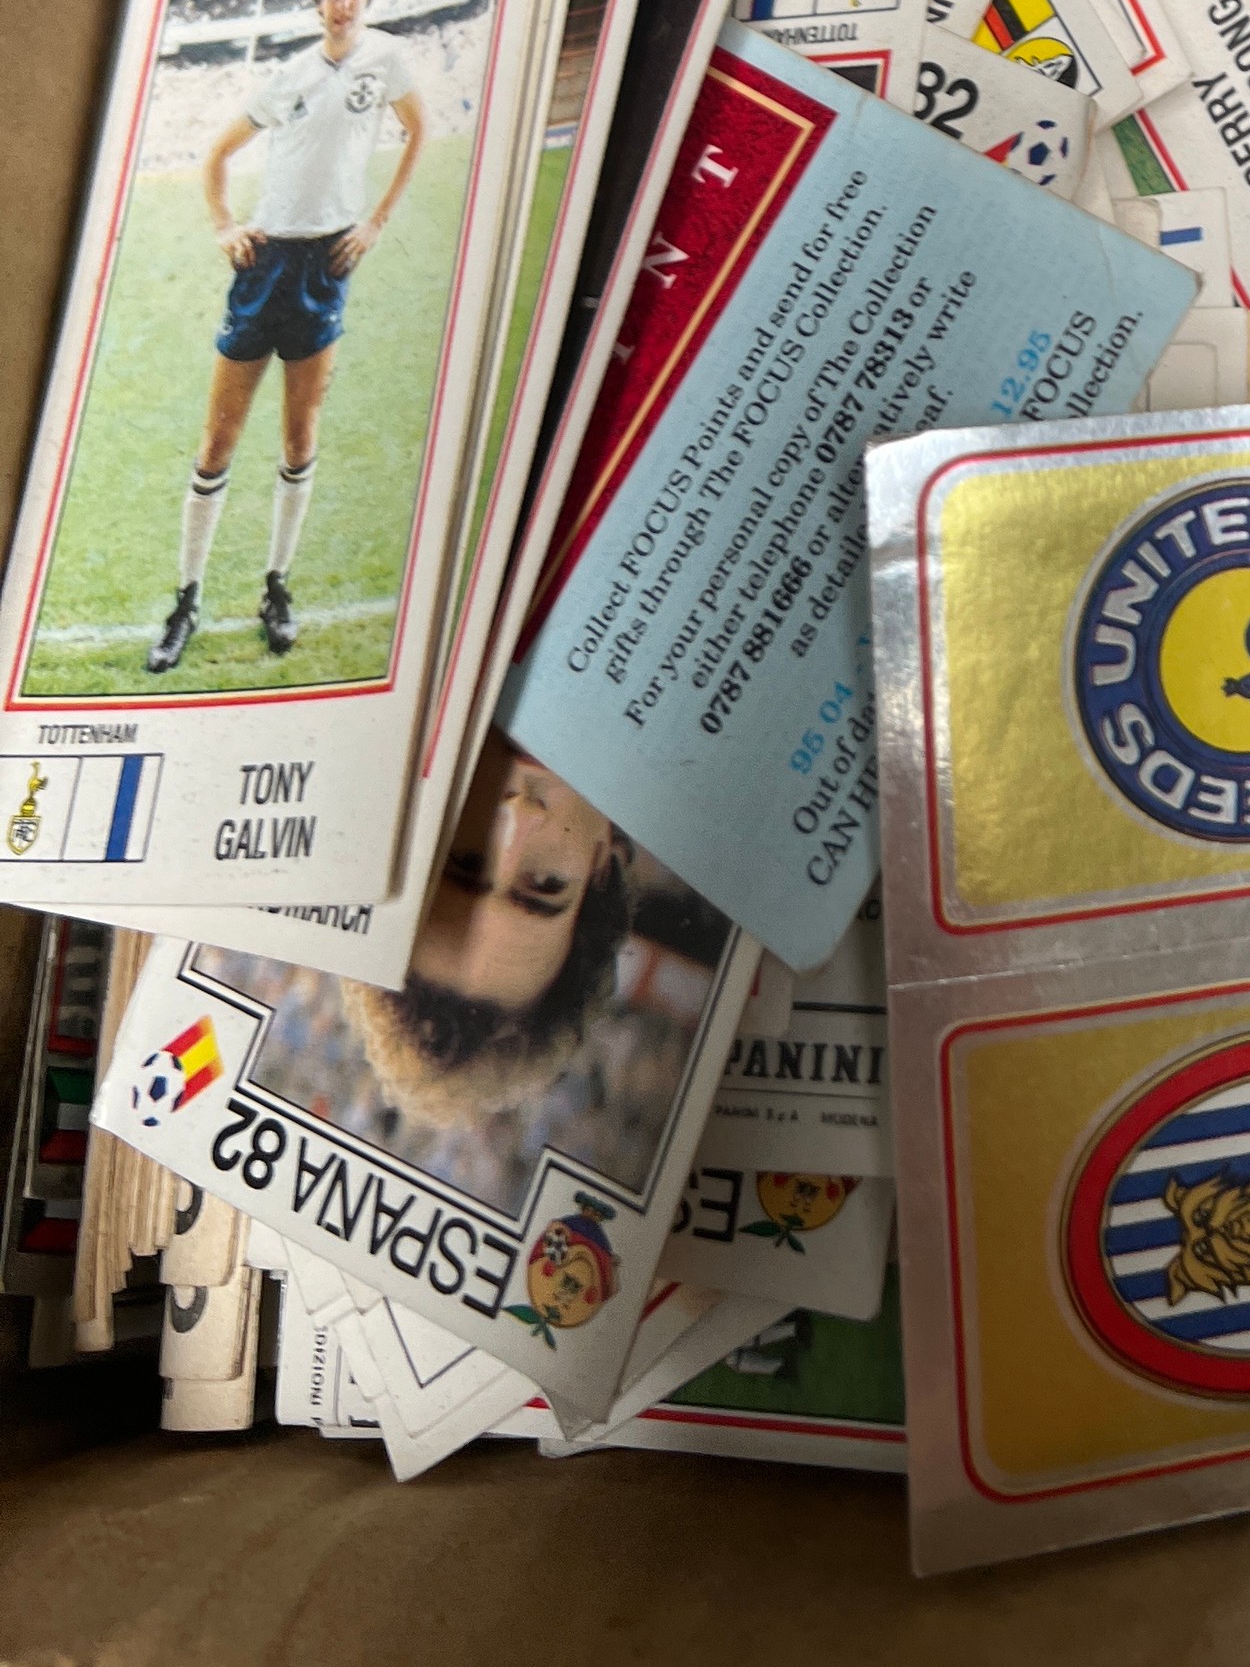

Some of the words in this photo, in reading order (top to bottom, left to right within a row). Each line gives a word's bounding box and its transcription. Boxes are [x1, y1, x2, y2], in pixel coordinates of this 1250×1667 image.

[566, 580, 632, 673] Collect
[618, 469, 693, 579] FOCUS
[680, 383, 745, 471] Points
[737, 326, 777, 382] and
[768, 261, 814, 329] send
[800, 222, 835, 263] for
[823, 170, 868, 223] free
[604, 617, 648, 685] gifts
[638, 507, 712, 616] through
[697, 449, 744, 502] The
[729, 338, 806, 448] FOCUS
[794, 206, 887, 338] Collection.
[622, 674, 666, 730] For
[657, 608, 705, 682] your
[698, 486, 775, 614] personal
[766, 425, 812, 488] copy
[812, 339, 861, 391] The
[847, 206, 937, 336] Collection
[691, 602, 747, 689] either
[737, 467, 826, 602] telephone
[813, 390, 865, 464] 0787
[853, 307, 916, 390] 78313
[699, 659, 751, 735] 0787
[741, 555, 813, 663] 881666
[926, 270, 977, 341] write
[792, 776, 841, 835] Out
[1019, 311, 1097, 422] FOCUS
[806, 806, 861, 887] CAN
[1062, 311, 1143, 419] llection.
[807, 524, 866, 622] detaile
[37, 723, 139, 744] TOTTENHAM
[214, 816, 318, 861] GALVIN
[239, 761, 316, 805] TONY
[212, 1097, 288, 1190] 82
